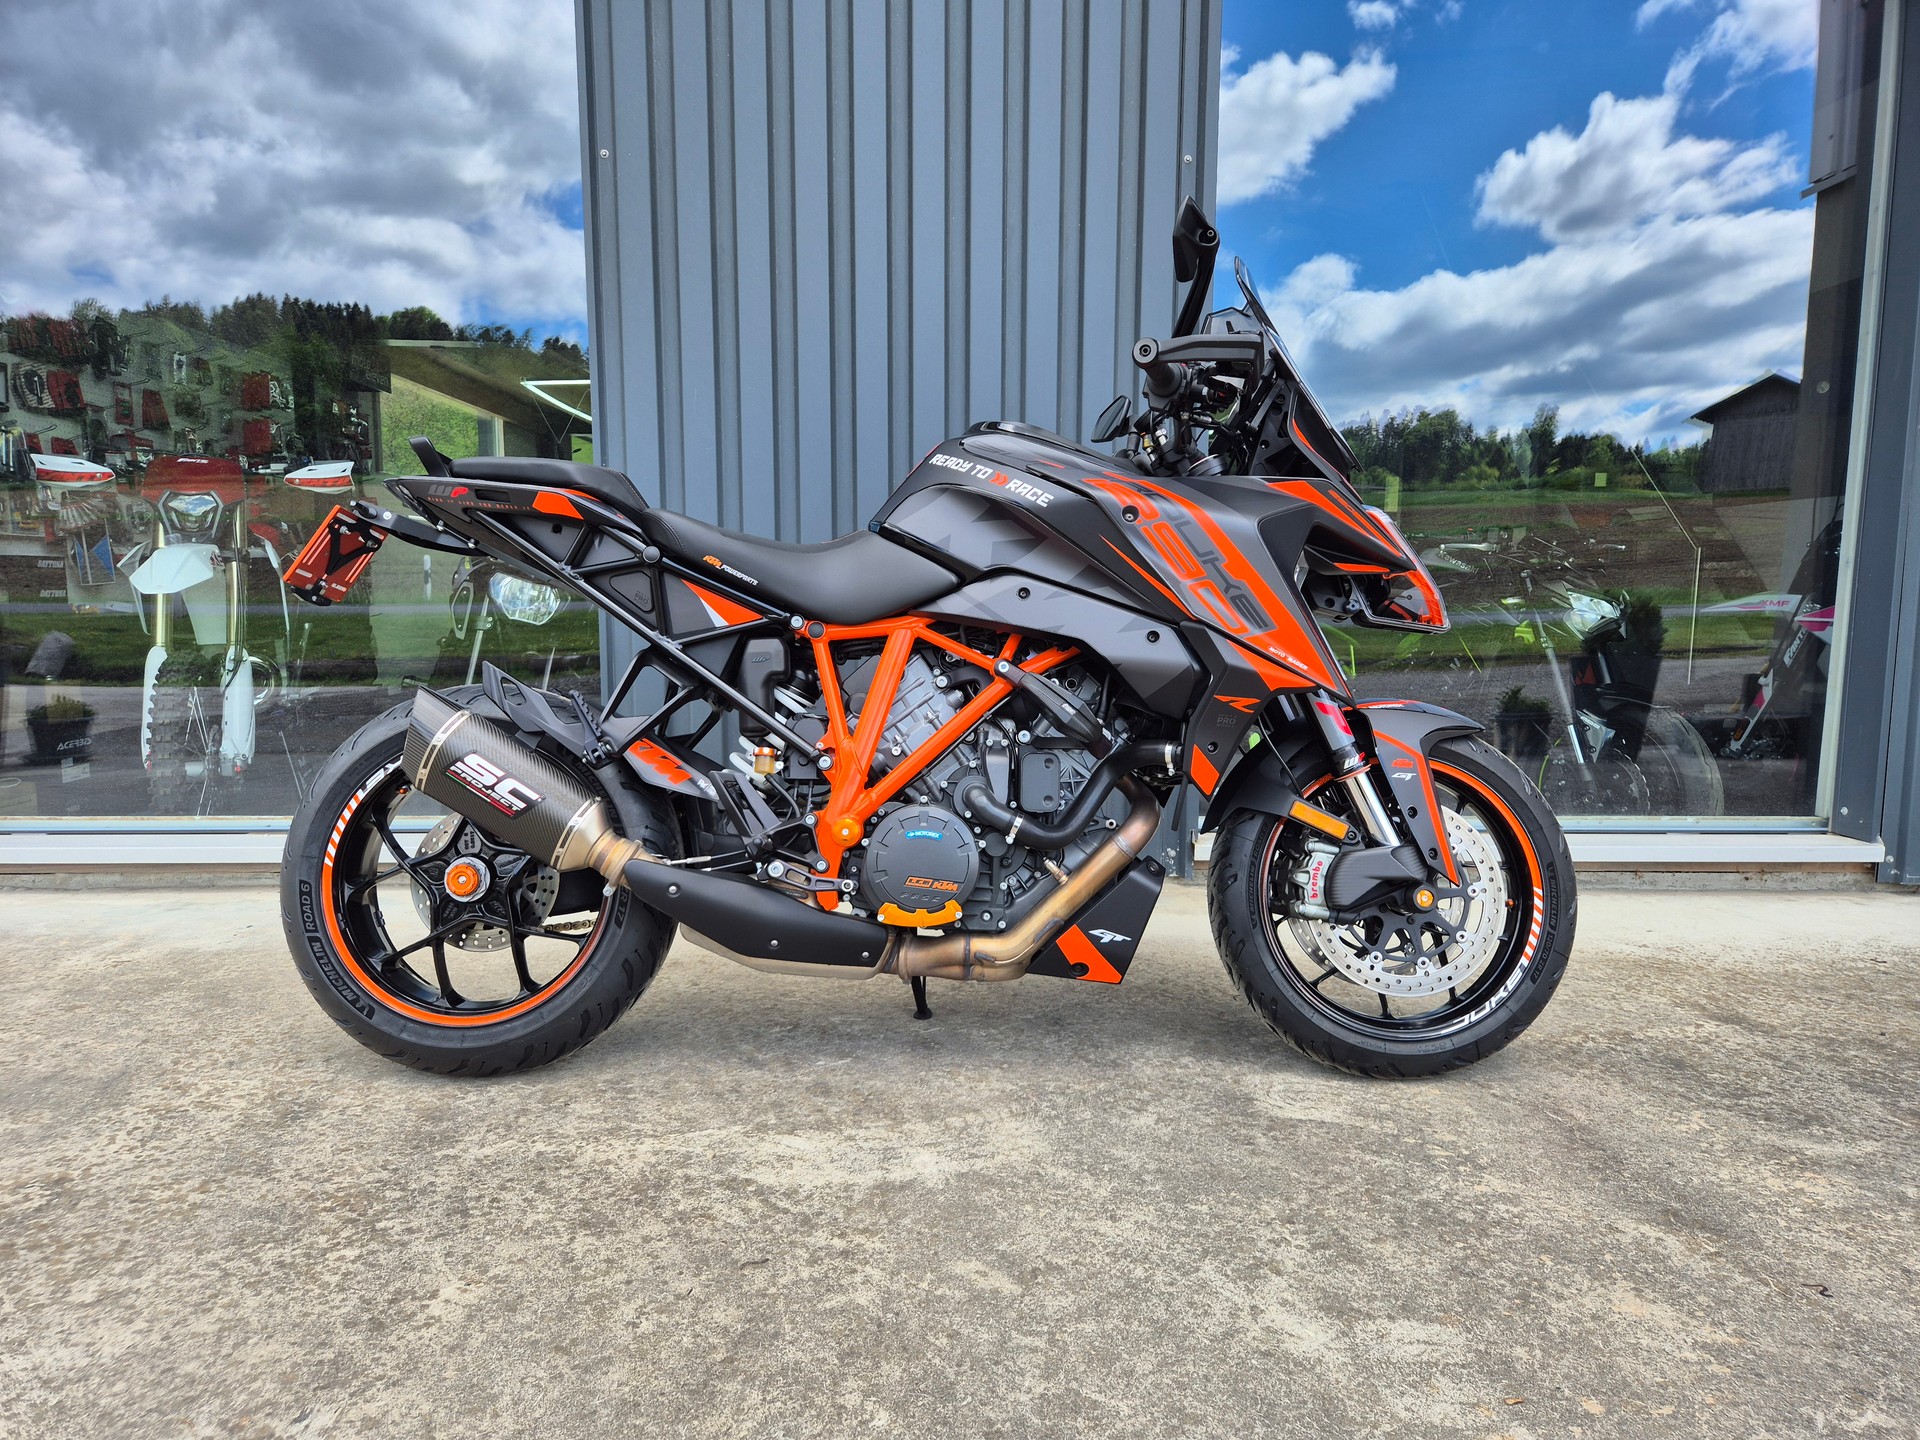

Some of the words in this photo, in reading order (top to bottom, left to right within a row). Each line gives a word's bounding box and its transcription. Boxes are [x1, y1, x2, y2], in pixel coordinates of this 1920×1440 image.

[428, 484, 469, 498] WP
[929, 453, 973, 472] READY
[971, 464, 994, 479] TO
[1005, 478, 1054, 507] RACE
[721, 564, 758, 586] POWERPARTS
[449, 765, 521, 811] PROJECT
[1391, 772, 1417, 781] GT
[300, 883, 311, 891] 6
[1310, 860, 1323, 899] brembo
[304, 894, 316, 930] ROAD
[1550, 879, 1558, 927] MICHELIN
[1088, 928, 1132, 943] GT
[311, 941, 358, 1001] MICHELIN
